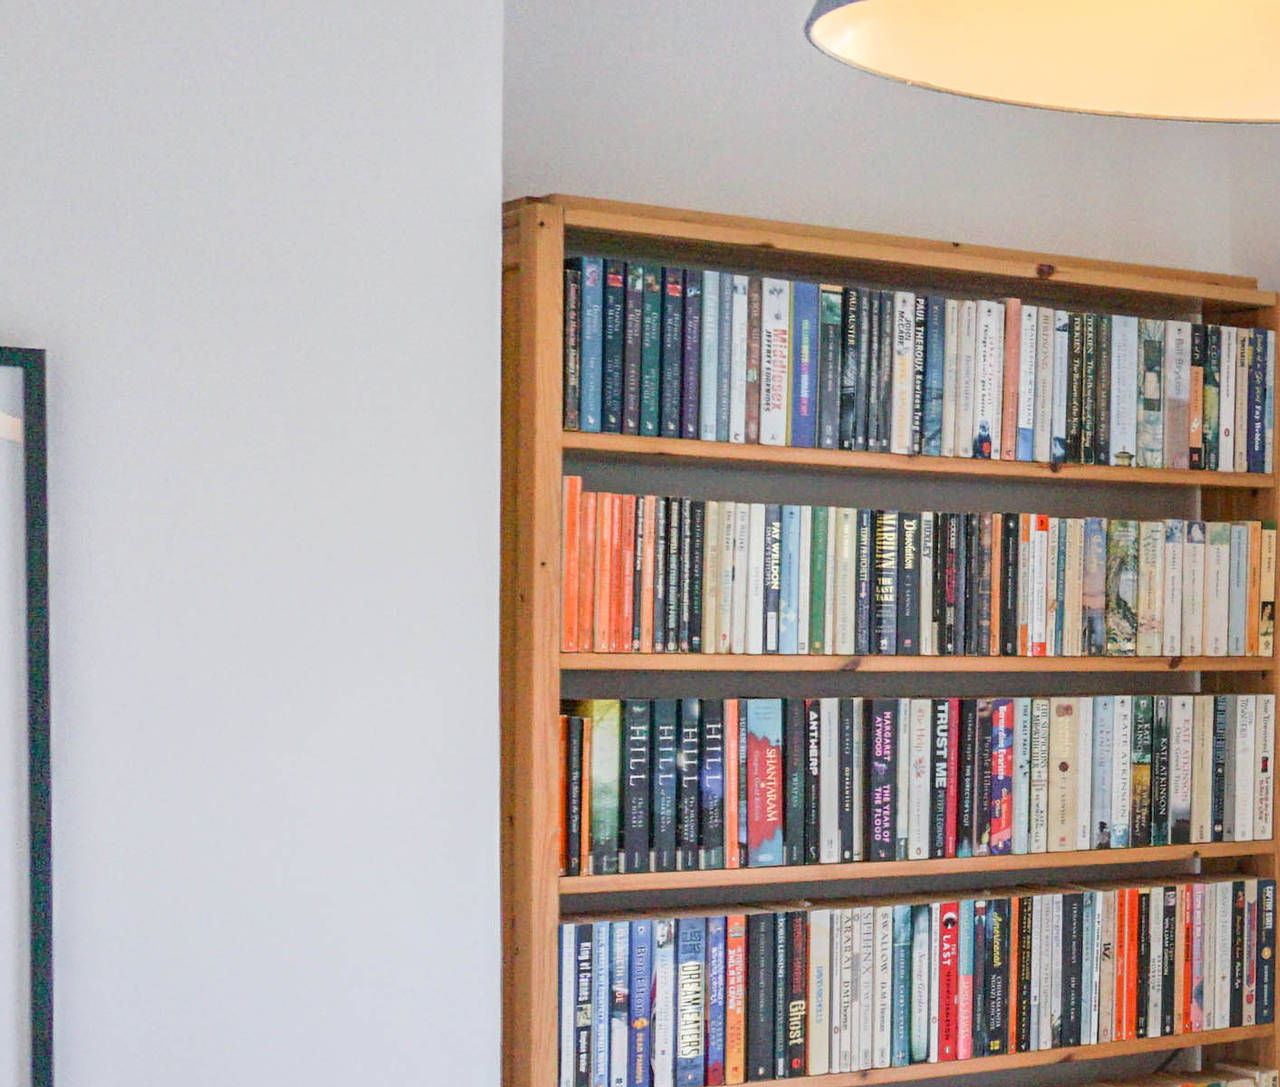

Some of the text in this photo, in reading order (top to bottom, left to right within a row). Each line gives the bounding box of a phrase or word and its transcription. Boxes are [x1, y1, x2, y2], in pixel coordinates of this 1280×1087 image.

[916, 298, 924, 322] PAUL
[1073, 317, 1081, 354] TOLKIEN
[771, 328, 788, 411] Middlesex
[915, 326, 923, 371] THEROUX
[771, 522, 781, 590] FAY WELDON
[875, 514, 897, 570] MARILYN
[904, 519, 917, 570] Dissolution
[923, 519, 932, 559] HUXLEY
[630, 725, 646, 786] HILL
[659, 725, 673, 786] HILL
[706, 723, 721, 787] HILL
[809, 711, 818, 776] ANTWERP
[883, 712, 891, 761] MARGARET
[936, 702, 948, 758] TRUST
[997, 706, 1006, 780] Bernardine Evaristo
[682, 728, 697, 788] HILL
[936, 763, 946, 788] ME
[766, 748, 776, 822] SHANTARAM
[1159, 766, 1167, 815] ATKINSON
[882, 831, 890, 843] OF
[942, 934, 951, 965] LAST
[992, 911, 1002, 968] Americanah
[681, 964, 701, 1008] DREAM
[789, 1000, 806, 1046] Ghost
